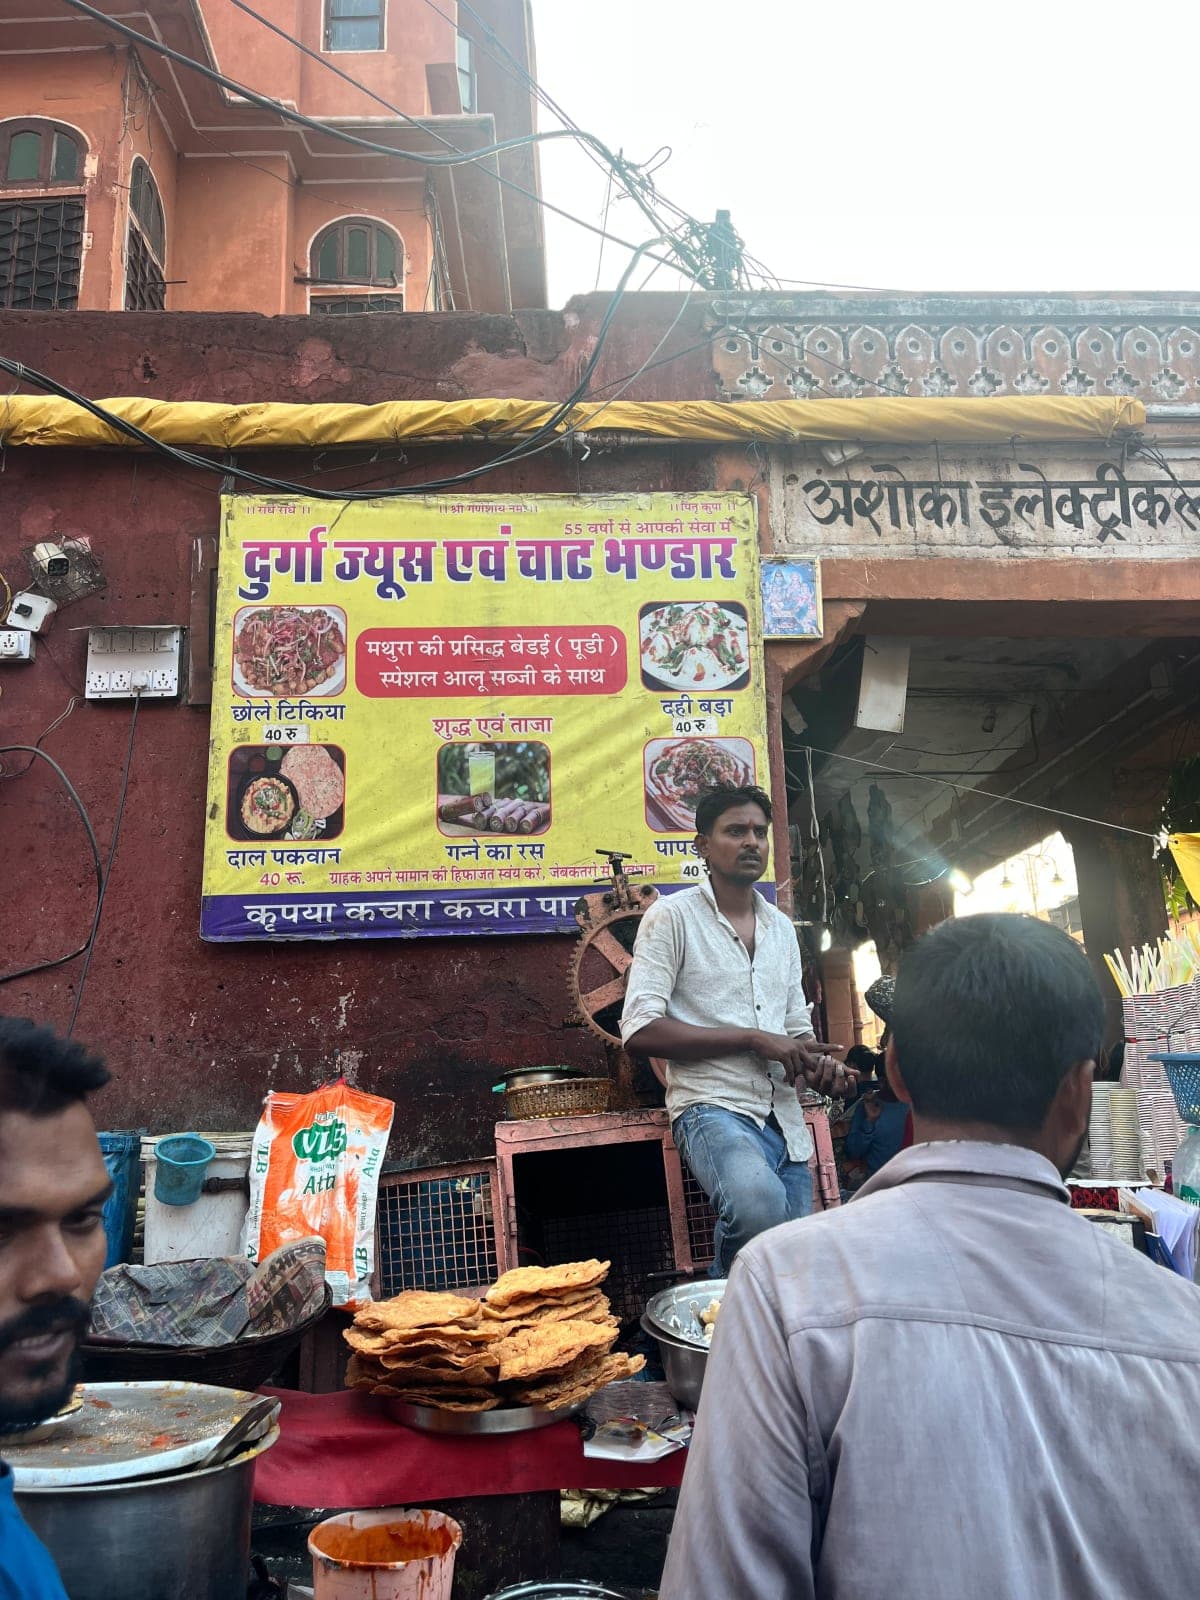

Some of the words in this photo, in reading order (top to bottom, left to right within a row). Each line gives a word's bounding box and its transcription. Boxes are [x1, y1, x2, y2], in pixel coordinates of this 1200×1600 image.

[564, 523, 583, 535] 55
[618, 518, 632, 534] से
[636, 518, 683, 534] आपकी
[688, 517, 715, 533] सेवा
[238, 526, 328, 600] दुर्गा
[334, 540, 437, 600] ज्यूस
[443, 525, 512, 582] एवं
[516, 539, 595, 581] चाट
[604, 538, 738, 581] भण्डार
[365, 640, 414, 662] मथुरा
[418, 635, 445, 656] की
[449, 634, 506, 658] प्रसिद्ध
[510, 633, 551, 656] बेडई
[379, 665, 438, 688] स्पेशल
[443, 669, 488, 692] आलू
[489, 664, 537, 686] सब्जी
[543, 663, 562, 685] के
[568, 668, 606, 684] साथ
[231, 699, 272, 721] छोले
[276, 699, 346, 720] टिकिया
[660, 693, 694, 718] दही
[265, 729, 281, 740] 40
[432, 717, 472, 740] शुद्ध
[475, 713, 507, 737] एवं
[509, 717, 553, 733] ताजा
[676, 721, 691, 732] 40
[226, 849, 266, 869] दाल
[271, 848, 341, 865] पकवान
[445, 839, 481, 861] गन्ने
[485, 844, 513, 860] का
[517, 843, 545, 860] रस
[259, 872, 281, 886] 40
[329, 871, 362, 886] ग्राहक
[365, 867, 393, 883] अपने
[395, 870, 429, 884] सामान
[432, 865, 448, 882] की
[451, 865, 495, 882] हिफाजत
[683, 865, 699, 877] 40
[243, 902, 338, 932] कृपया
[342, 899, 435, 921] कचरा
[440, 897, 530, 920] कचरा
[536, 896, 582, 917] पा
[362, 1147, 381, 1179] Atta
[303, 1172, 336, 1195] Atta
